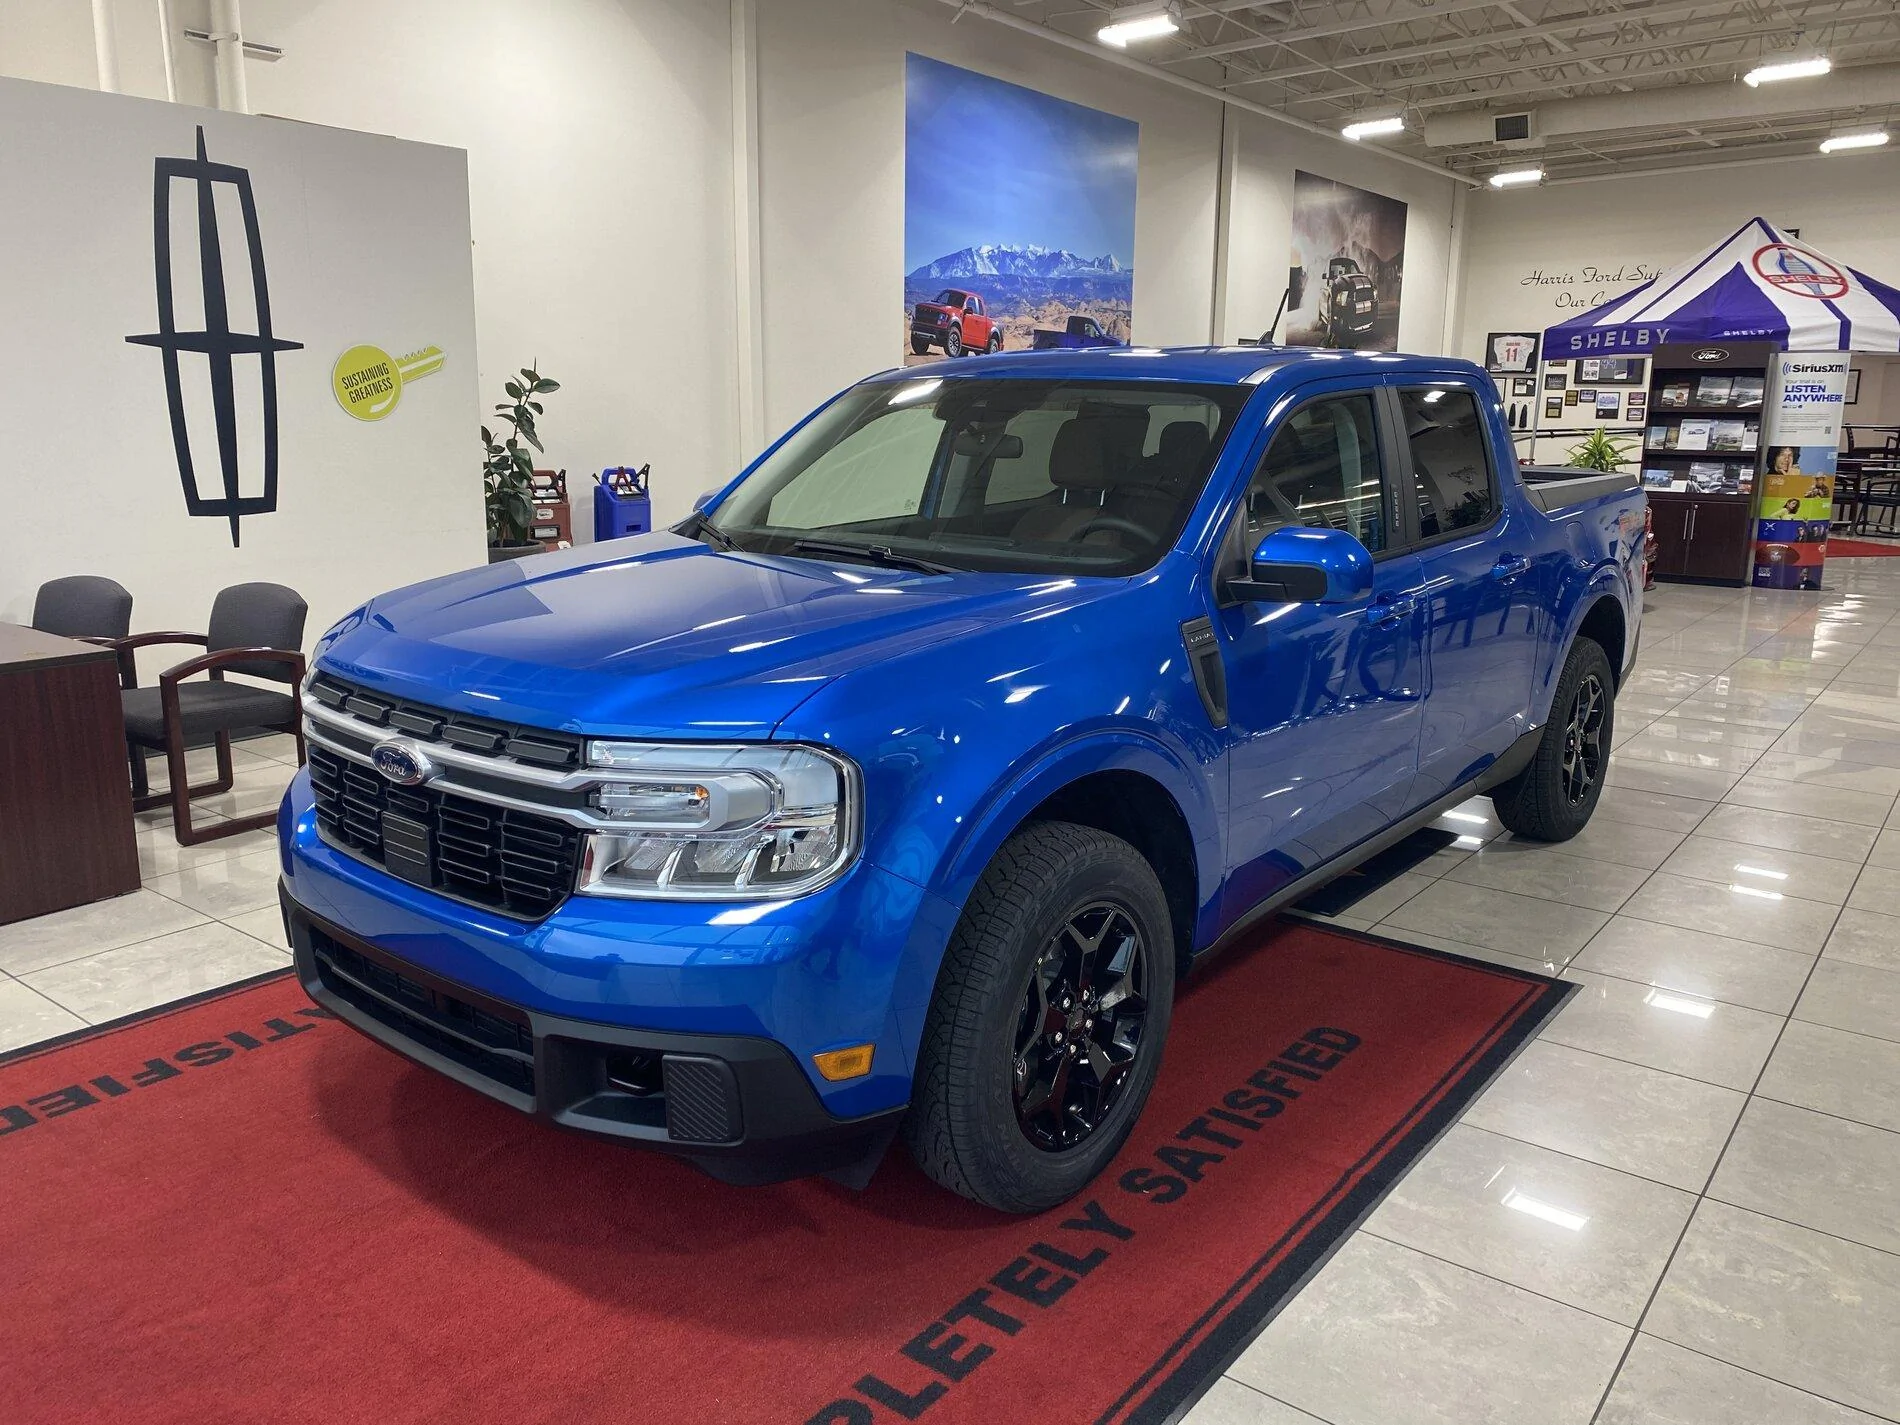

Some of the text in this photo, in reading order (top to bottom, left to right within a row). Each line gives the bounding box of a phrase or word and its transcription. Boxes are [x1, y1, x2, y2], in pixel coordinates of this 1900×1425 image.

[1521, 270, 1575, 286] Harris
[1583, 265, 1625, 283] Ford
[1769, 274, 1842, 285] SHELBY
[1555, 292, 1585, 308] Our
[1570, 329, 1670, 350] SHELBY
[1505, 347, 1519, 363] 11
[1698, 349, 1722, 360] Ford
[342, 362, 389, 390] SUSTAINING
[349, 377, 393, 403] GREATNESS
[1783, 394, 1843, 402] ANYWHERE
[1784, 385, 1826, 393] LISTEN
[381, 751, 406, 776] Ford
[1118, 1027, 1362, 1203] SATISFIED
